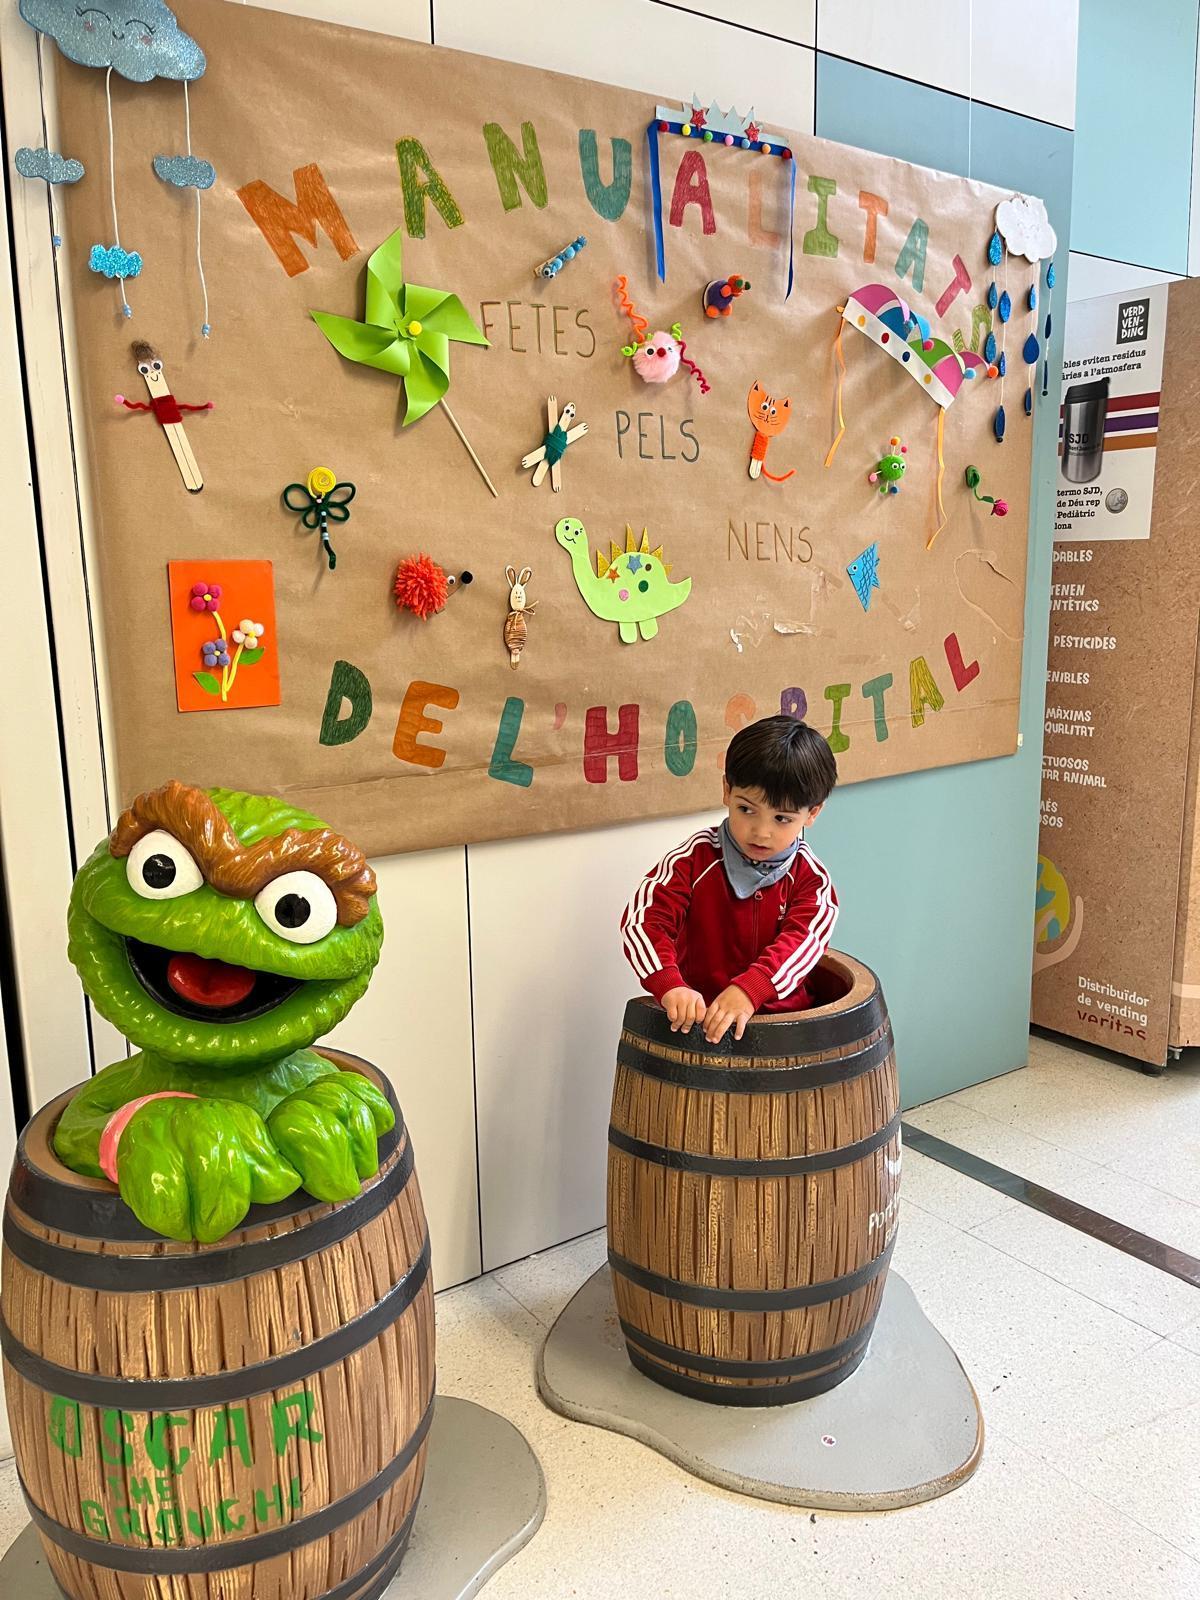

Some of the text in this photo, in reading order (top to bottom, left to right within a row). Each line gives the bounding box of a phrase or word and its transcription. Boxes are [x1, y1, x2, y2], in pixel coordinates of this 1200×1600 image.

[1122, 305, 1145, 318] VERD
[480, 301, 596, 358] FETES
[1122, 316, 1144, 329] VEN-
[1121, 326, 1144, 339] DING
[1062, 349, 1146, 369] bles eviten residus
[1091, 362, 1141, 377] l'atmosfera
[615, 410, 700, 463] PELS
[1069, 432, 1089, 444] SJD
[1056, 486, 1103, 497] termo SJD,
[1056, 499, 1101, 508] de Déu rep
[1056, 509, 1096, 519] Pediàtric
[728, 519, 813, 563] NENS
[1053, 549, 1093, 563] DABLES
[1053, 635, 1117, 650] PESTICIDES
[319, 660, 460, 768] DE
[1046, 706, 1092, 722] MÀXIMS
[1044, 721, 1095, 737] QUALITAT
[1063, 771, 1107, 788] ANIMAL
[1039, 813, 1064, 828] SOS
[1078, 975, 1150, 1007] Distribuïdor
[1077, 992, 1148, 1027] de vending
[49, 1391, 324, 1475] OSCAR
[106, 1476, 173, 1504] THE
